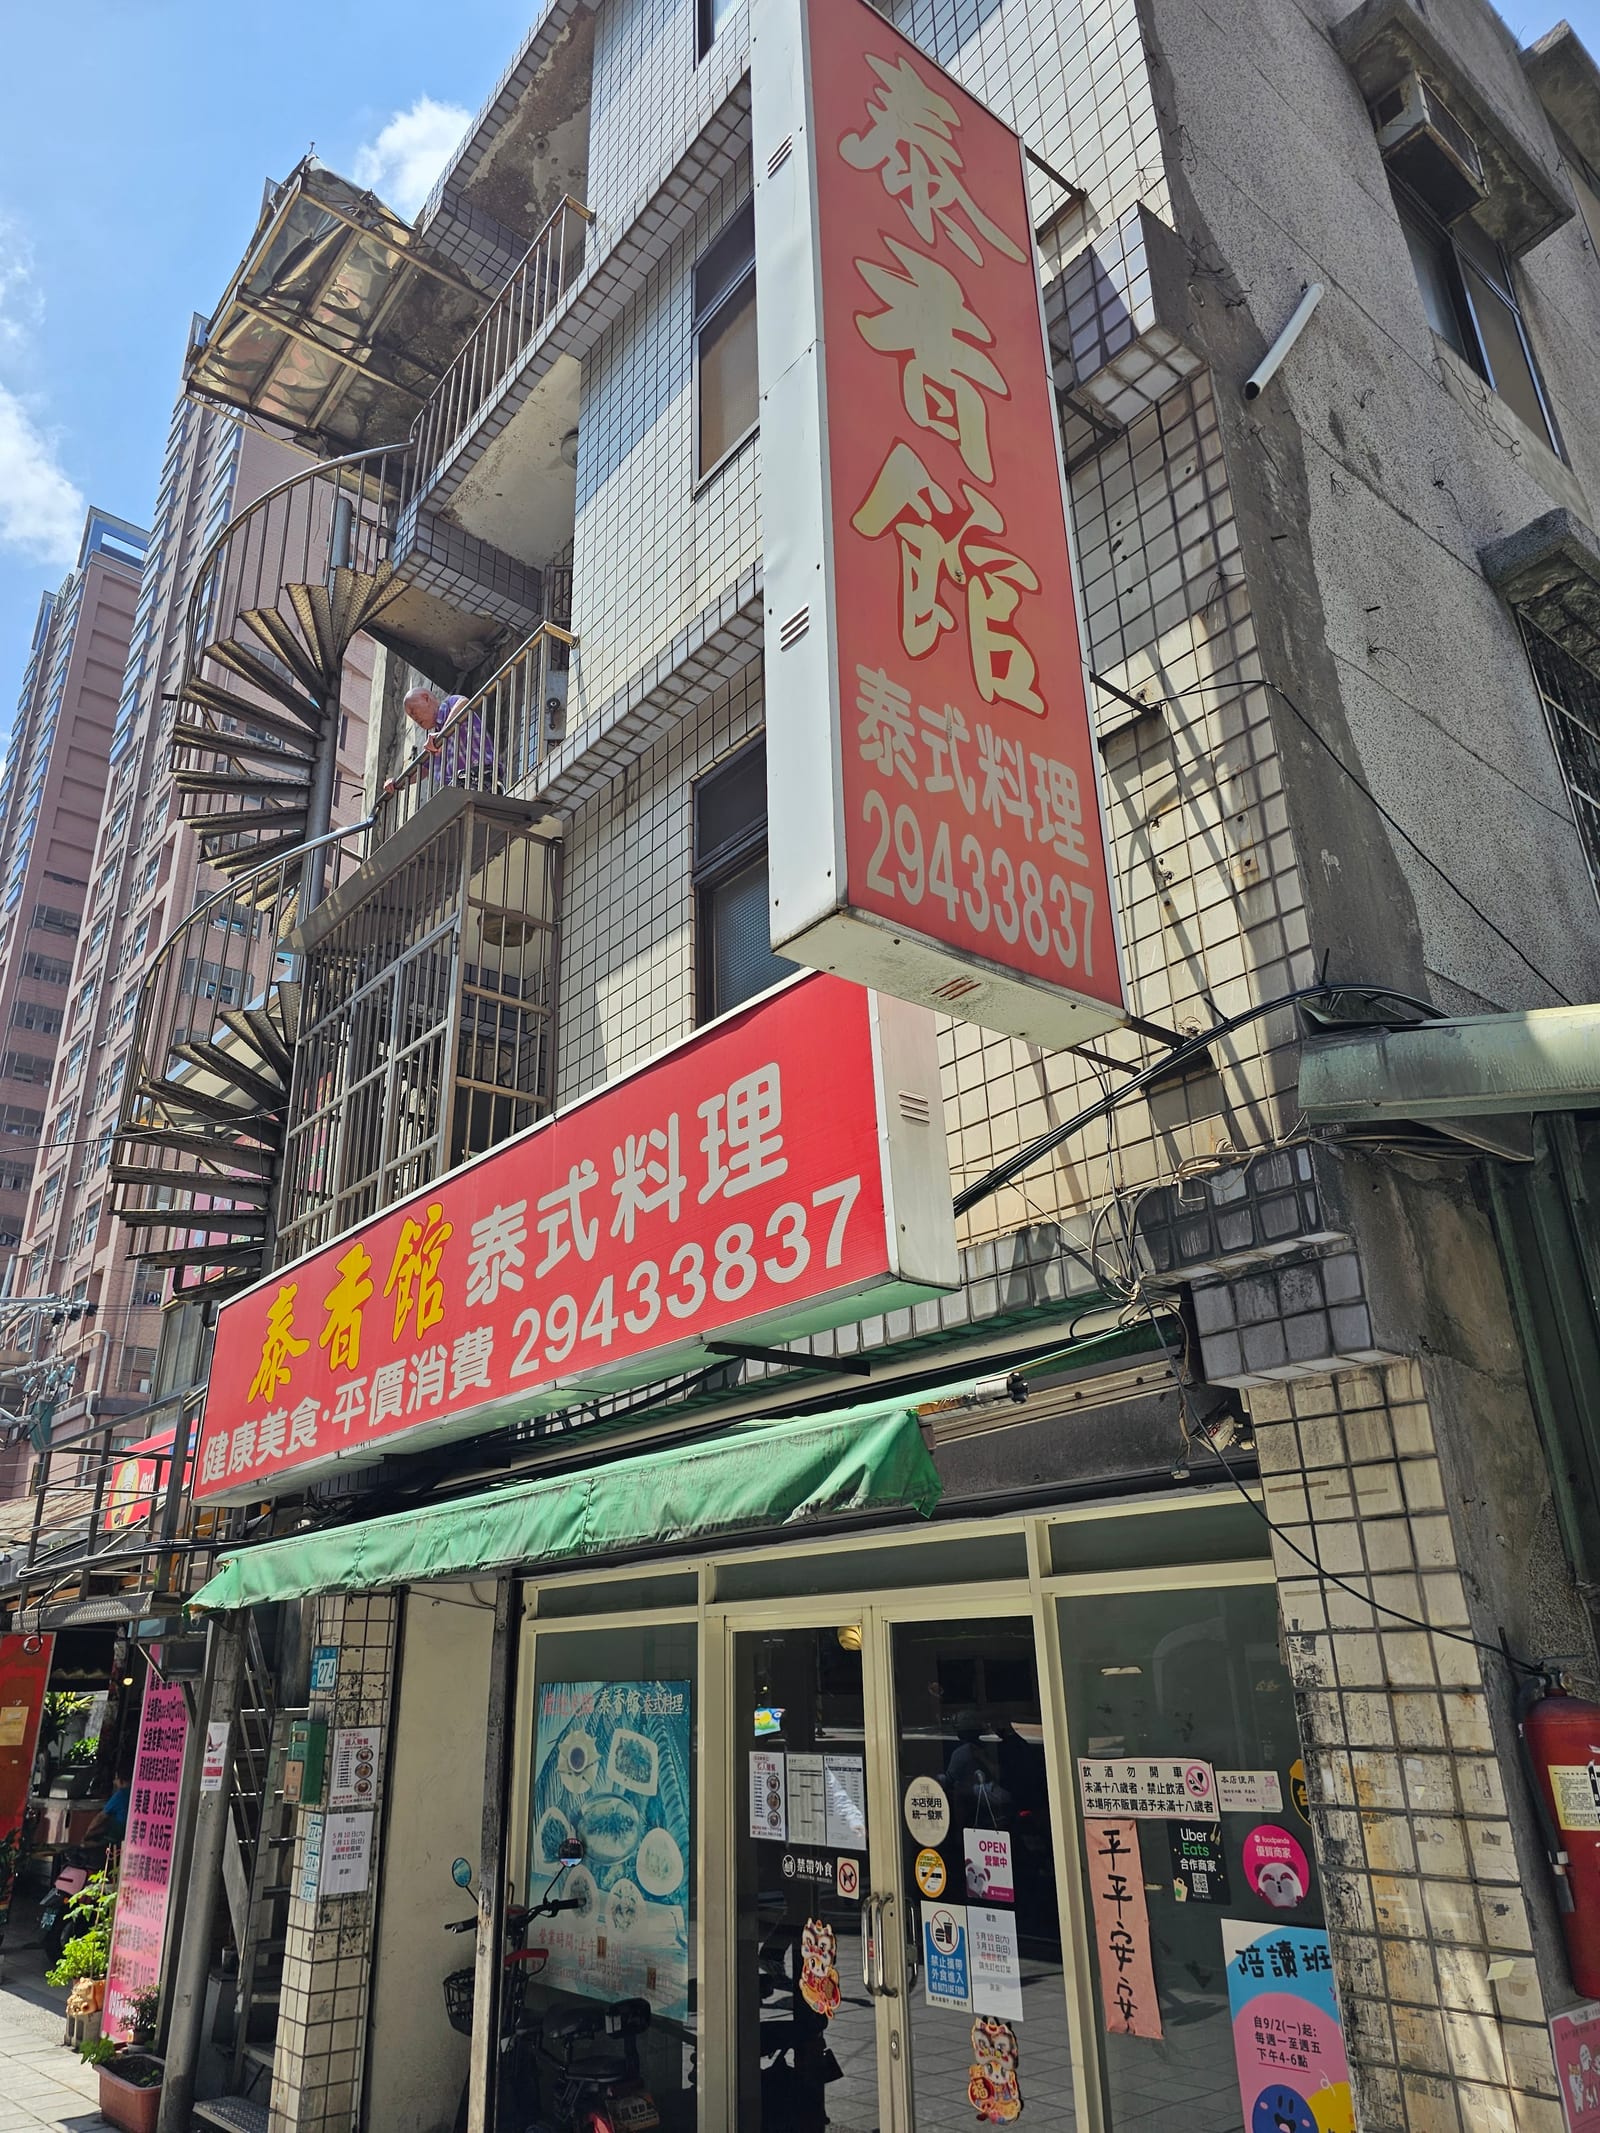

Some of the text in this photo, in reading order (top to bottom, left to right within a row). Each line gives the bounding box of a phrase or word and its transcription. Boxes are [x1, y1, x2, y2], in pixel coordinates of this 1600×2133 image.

[838, 52, 1048, 719] 泰香館
[856, 664, 1090, 868] 泰式料理
[862, 789, 1095, 978] 29433837
[466, 1062, 789, 1307] 泰式料理
[508, 1174, 861, 1380] 29433837
[247, 1202, 454, 1405] 泰香館
[317, 1661, 336, 1685] 274
[1082, 1765, 1184, 1778] 飲酒勿開車
[912, 1809, 943, 1820] 統一發票
[1180, 1828, 1208, 1843] Uber
[1261, 1836, 1290, 1845] foodpanda
[978, 1840, 1007, 1854] OPEN
[1182, 1843, 1210, 1857] Eats
[1255, 1844, 1292, 1859] 優質商家
[796, 1857, 833, 1878] 禁帶外食
[984, 1855, 1008, 1868] 營業中
[1179, 1858, 1217, 1873] 合作商家
[1234, 1940, 1332, 1978] 陪讀班
[931, 1968, 964, 1985] 外食進入
[1253, 2014, 1318, 2038] 自9/2(一)起:
[1254, 2030, 1322, 2055] 每週一至週五
[1256, 2046, 1309, 2069] 下午4-6點
